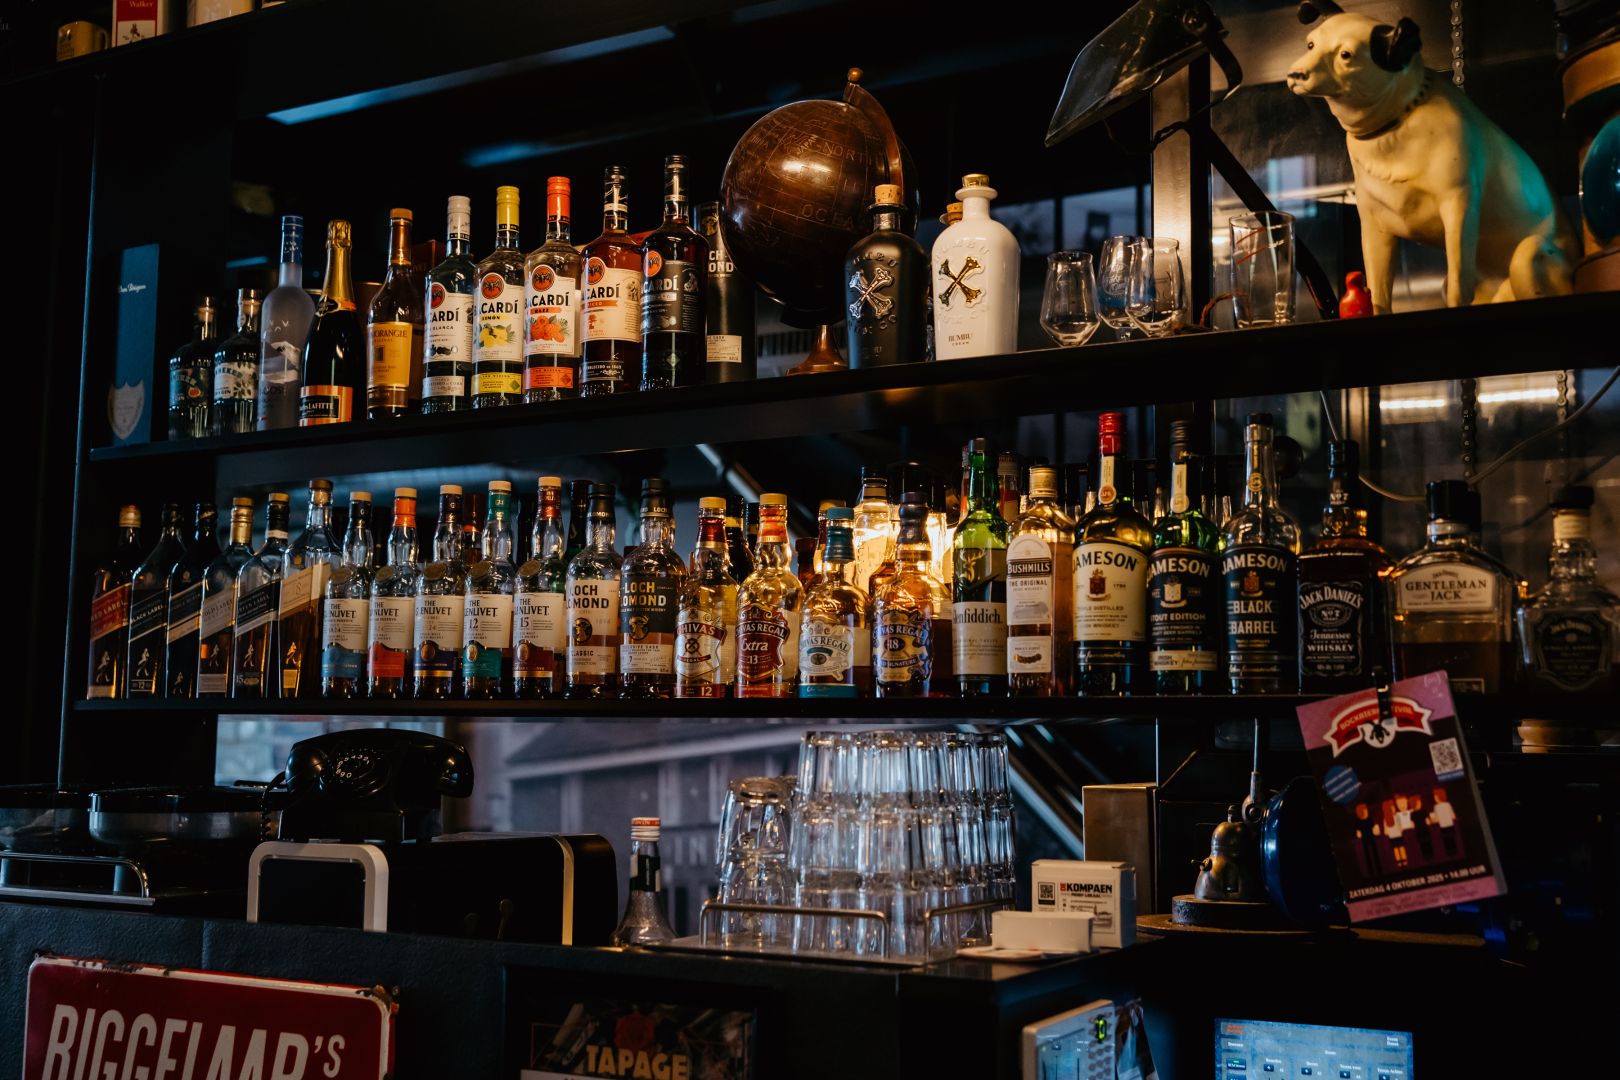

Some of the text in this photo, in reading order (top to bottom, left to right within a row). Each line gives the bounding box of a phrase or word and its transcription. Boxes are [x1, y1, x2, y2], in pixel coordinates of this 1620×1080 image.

[643, 275, 679, 291] CARDÍ
[585, 283, 620, 299] ARDÍ
[525, 292, 570, 308] CARDÍ
[477, 300, 519, 314] CARDÍ
[430, 308, 460, 323] ARDÍ
[373, 329, 408, 338] ORANGIE
[1007, 562, 1051, 574] BUSHMILLS
[1072, 551, 1138, 575] JAMESON
[1221, 553, 1288, 575] JAMESON
[1147, 557, 1211, 582] JAMESON
[571, 585, 598, 596] OCH
[624, 582, 655, 594] LOCH
[1405, 579, 1487, 591] GENTLEMAN
[621, 595, 667, 607] OMOND
[1300, 586, 1362, 610] JACK DANIEL'S
[1430, 590, 1463, 601] JACK
[416, 607, 452, 616] ENLIVET
[464, 607, 498, 617] ENLIVET
[516, 606, 550, 616] NLIVET
[1233, 600, 1273, 614] BLACK
[953, 607, 1001, 624] enfiddich
[1170, 613, 1206, 621] EDITION
[469, 618, 479, 629] 12
[520, 617, 529, 628] 15
[1230, 620, 1278, 635] BARREL
[757, 624, 785, 638] REGAL
[741, 638, 769, 651] Extra
[820, 637, 848, 653] REGAL
[889, 639, 899, 649] 18
[1307, 644, 1355, 652] WHISKEY
[749, 655, 758, 665] 13
[701, 686, 713, 697] 12
[1066, 883, 1113, 894] KOMPAEN
[1348, 885, 1385, 899] ZATERDAG
[1386, 884, 1391, 892] 4
[1392, 877, 1425, 890] OKTOBER
[586, 1044, 690, 1080] TAPAGE
